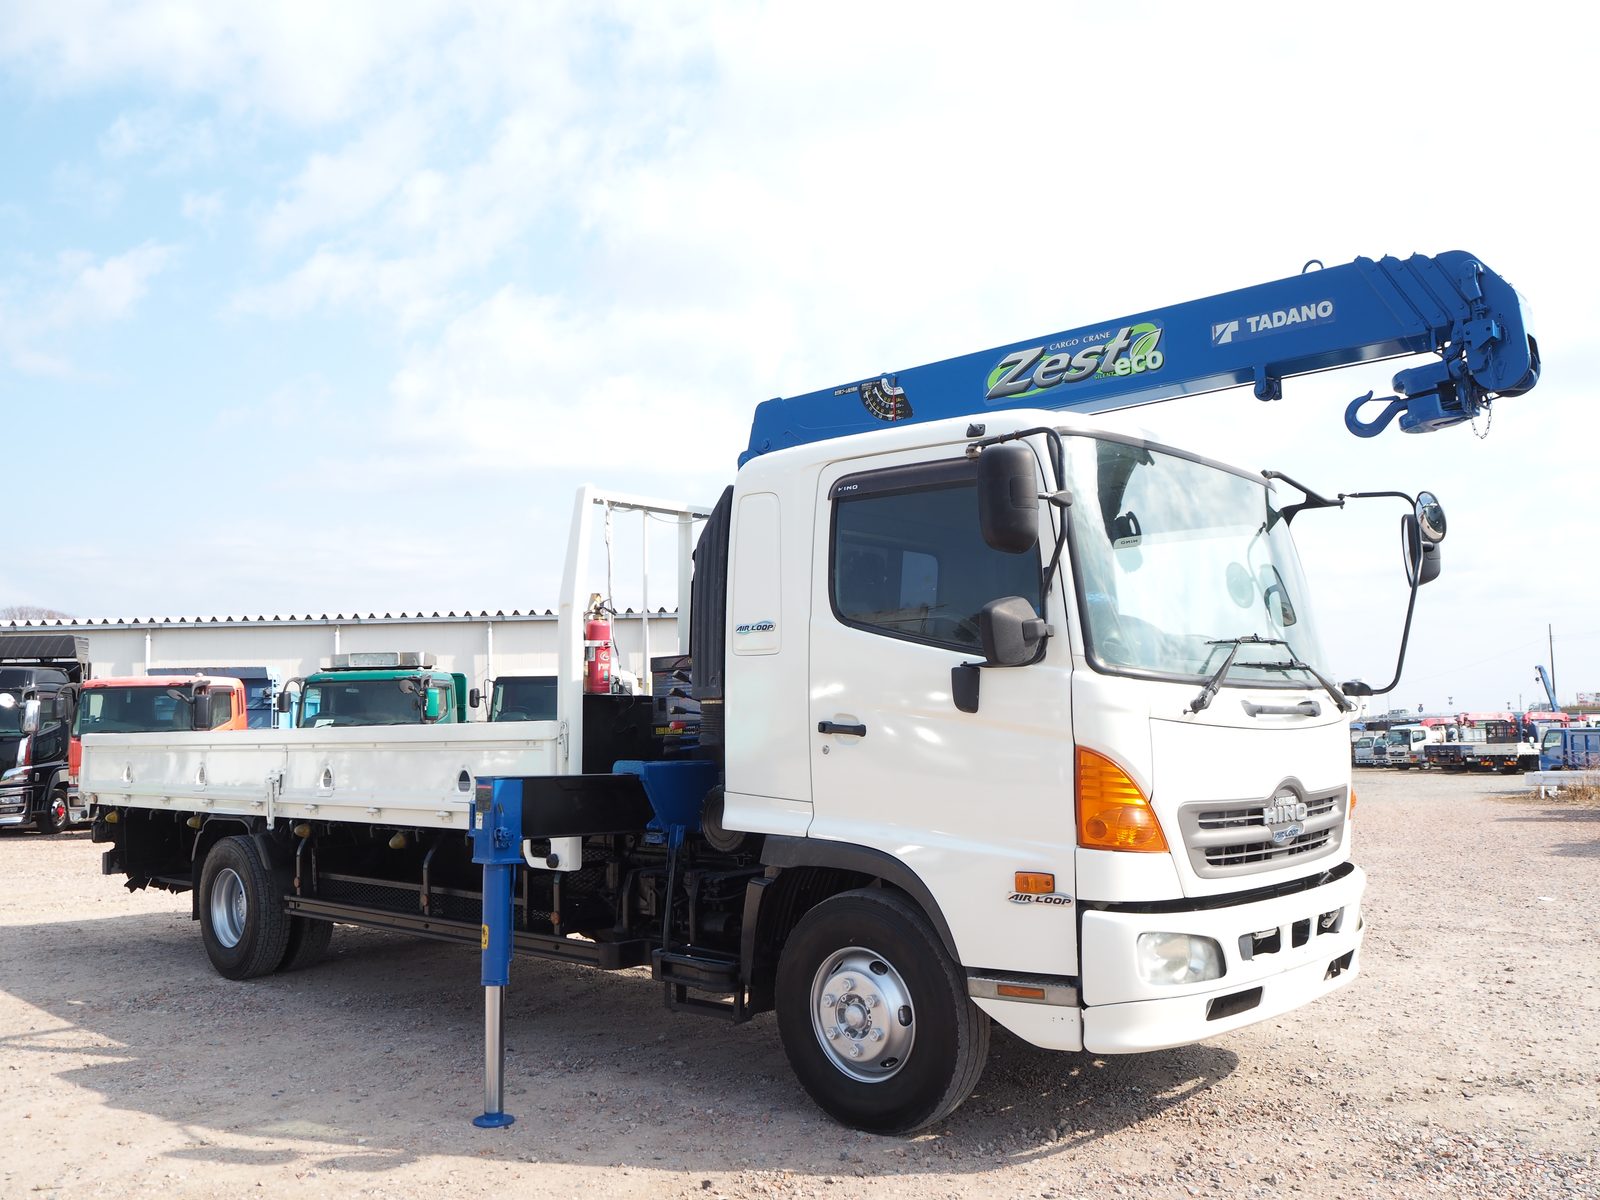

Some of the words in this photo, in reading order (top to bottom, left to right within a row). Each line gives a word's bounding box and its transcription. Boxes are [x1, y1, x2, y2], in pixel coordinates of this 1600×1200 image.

[1247, 301, 1333, 332] TADANO
[1050, 338, 1079, 350] CARGO
[1083, 331, 1111, 344] CRANE
[985, 326, 1134, 400] Zest
[1115, 351, 1165, 376] eco
[1263, 803, 1308, 825] HINO
[1008, 893, 1032, 902] AIR
[1036, 896, 1072, 905] LOOP
